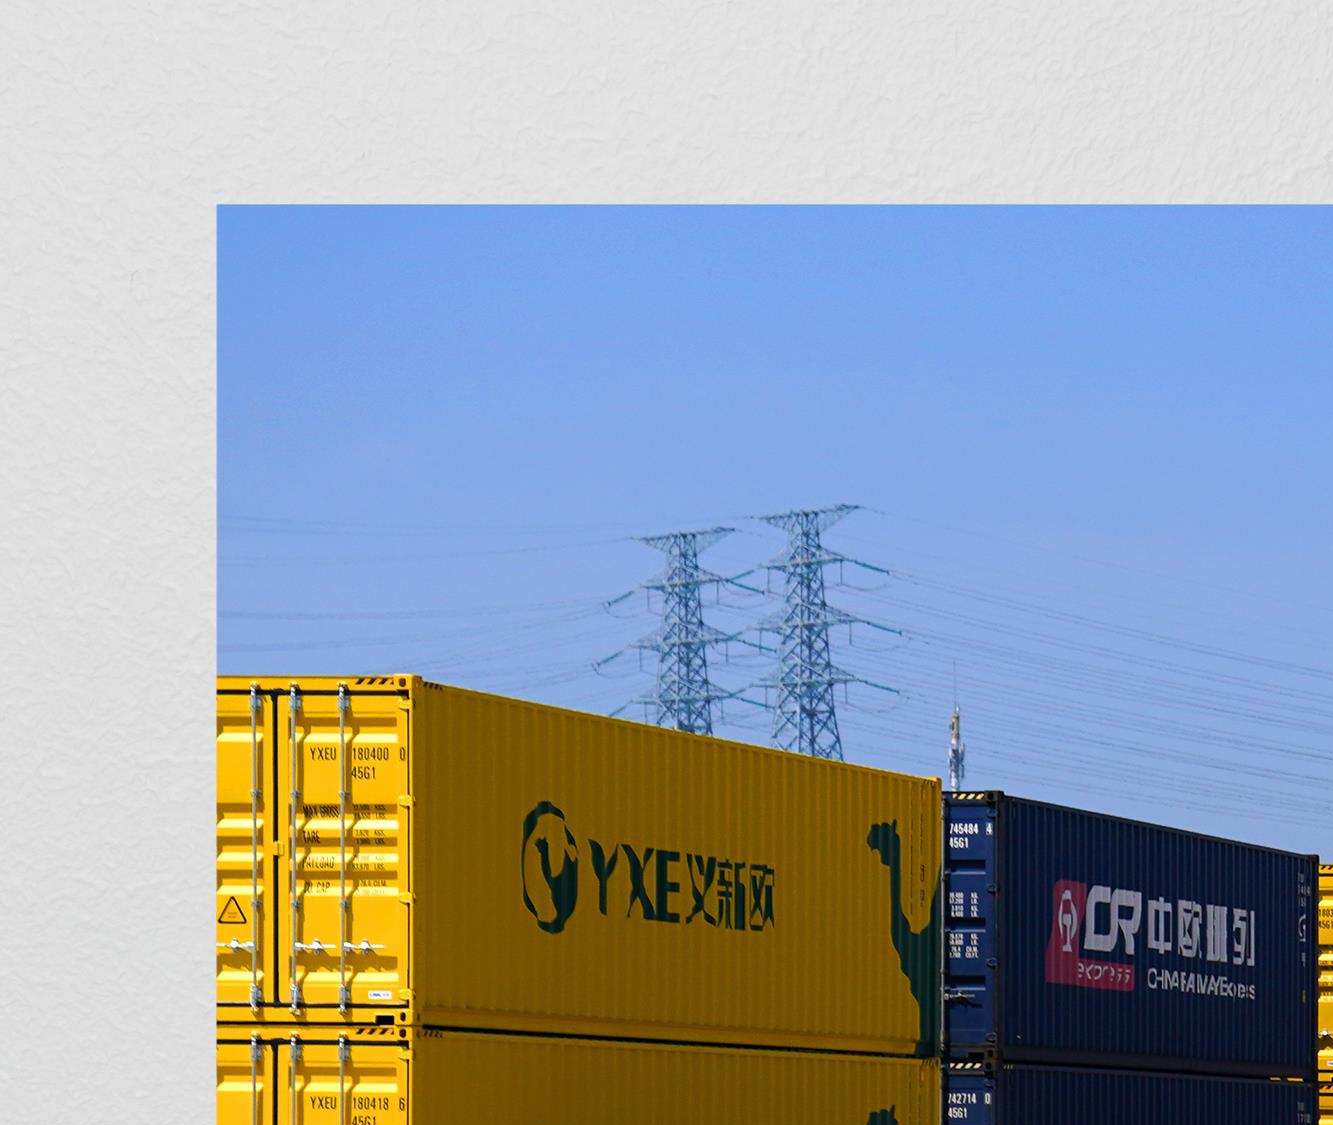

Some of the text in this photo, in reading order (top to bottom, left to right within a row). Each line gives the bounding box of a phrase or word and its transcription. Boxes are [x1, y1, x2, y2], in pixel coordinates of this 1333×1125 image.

[310, 747, 406, 762] YXEU 180400 0
[351, 766, 376, 780] 45G1
[986, 823, 993, 835] 4
[310, 1096, 406, 1112] YXEU 180418 6
[947, 1107, 968, 1119] 45G1
